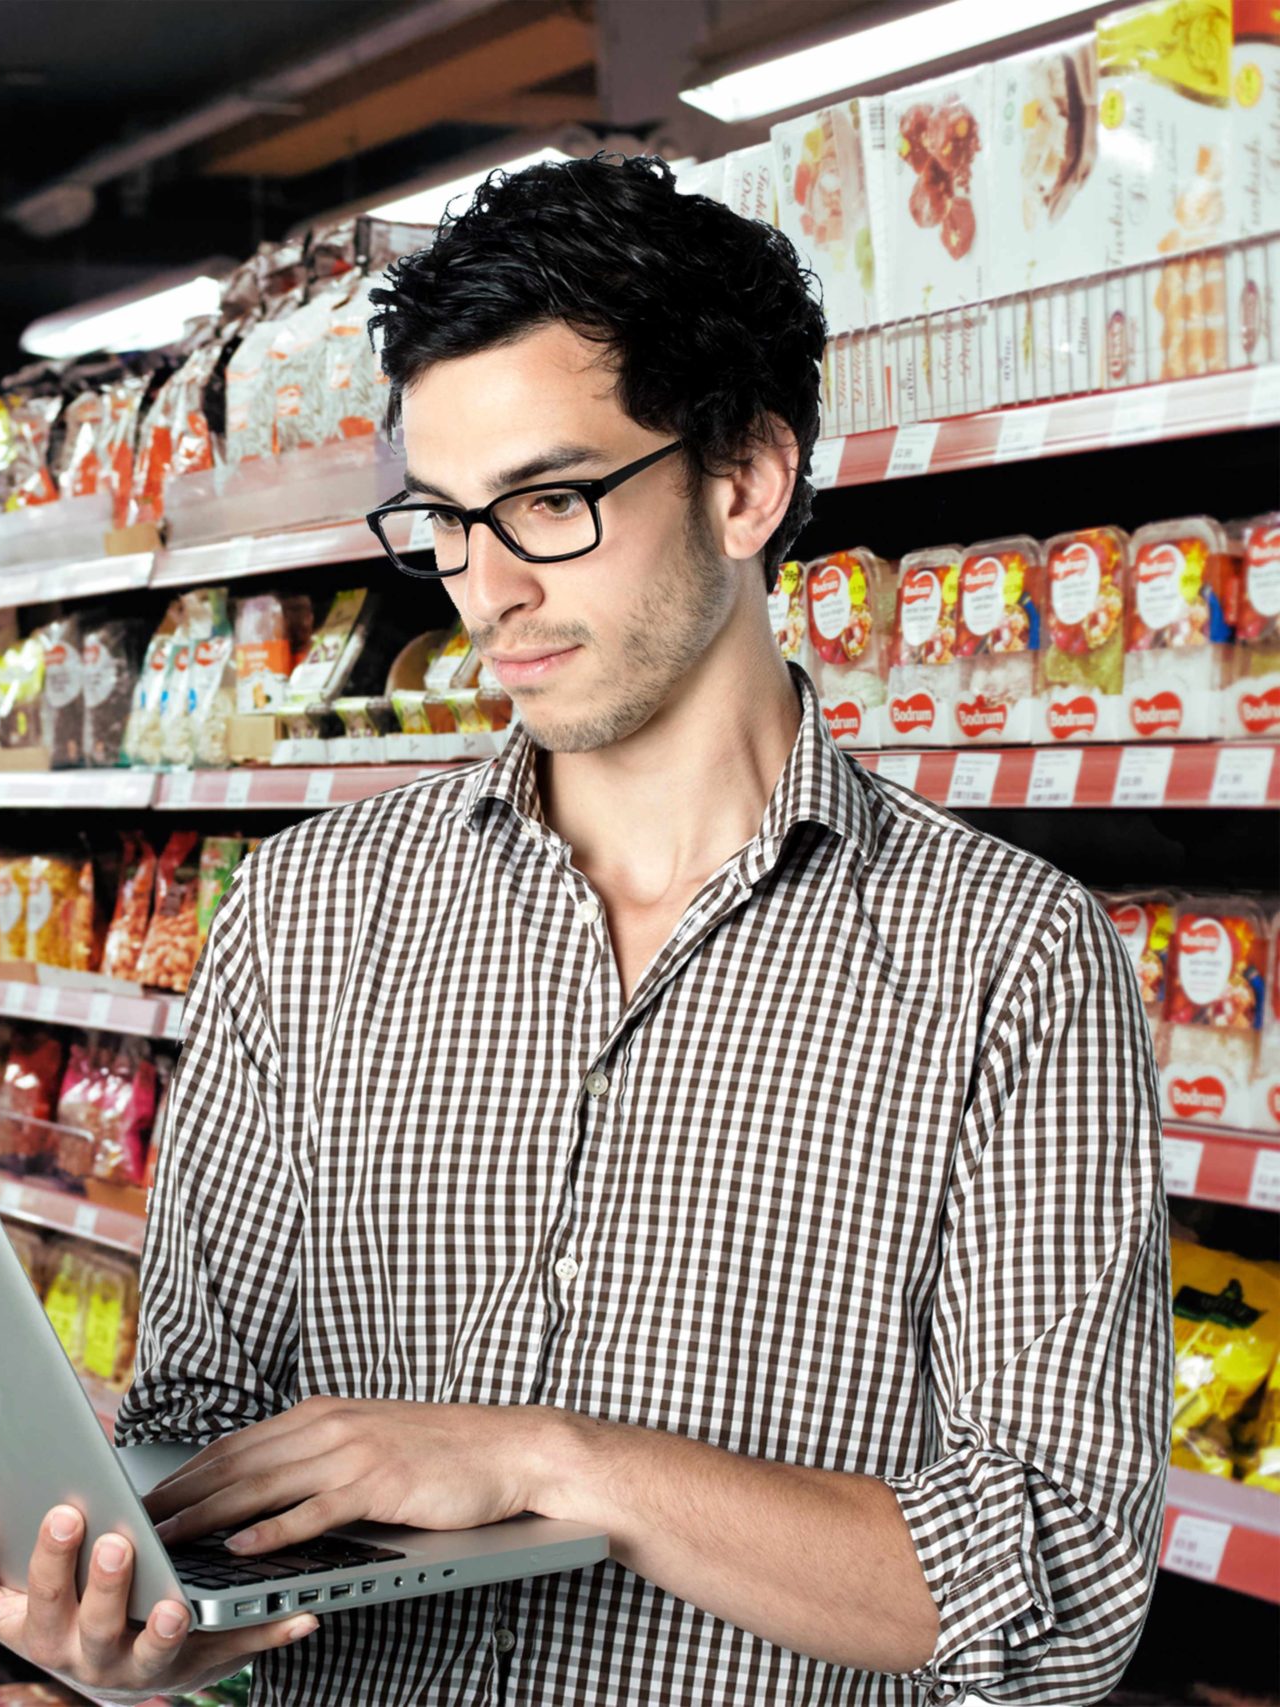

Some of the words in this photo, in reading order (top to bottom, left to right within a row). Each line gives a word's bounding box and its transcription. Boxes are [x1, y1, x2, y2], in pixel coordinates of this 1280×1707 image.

[812, 580, 839, 594] Bodrum
[828, 715, 858, 730] odrum
[893, 707, 932, 723] Bodrum
[959, 709, 1004, 726] Bodrum
[1050, 708, 1095, 727] Bodrum
[1134, 705, 1179, 724] Bodrum
[1173, 1086, 1222, 1108] Bodrum
